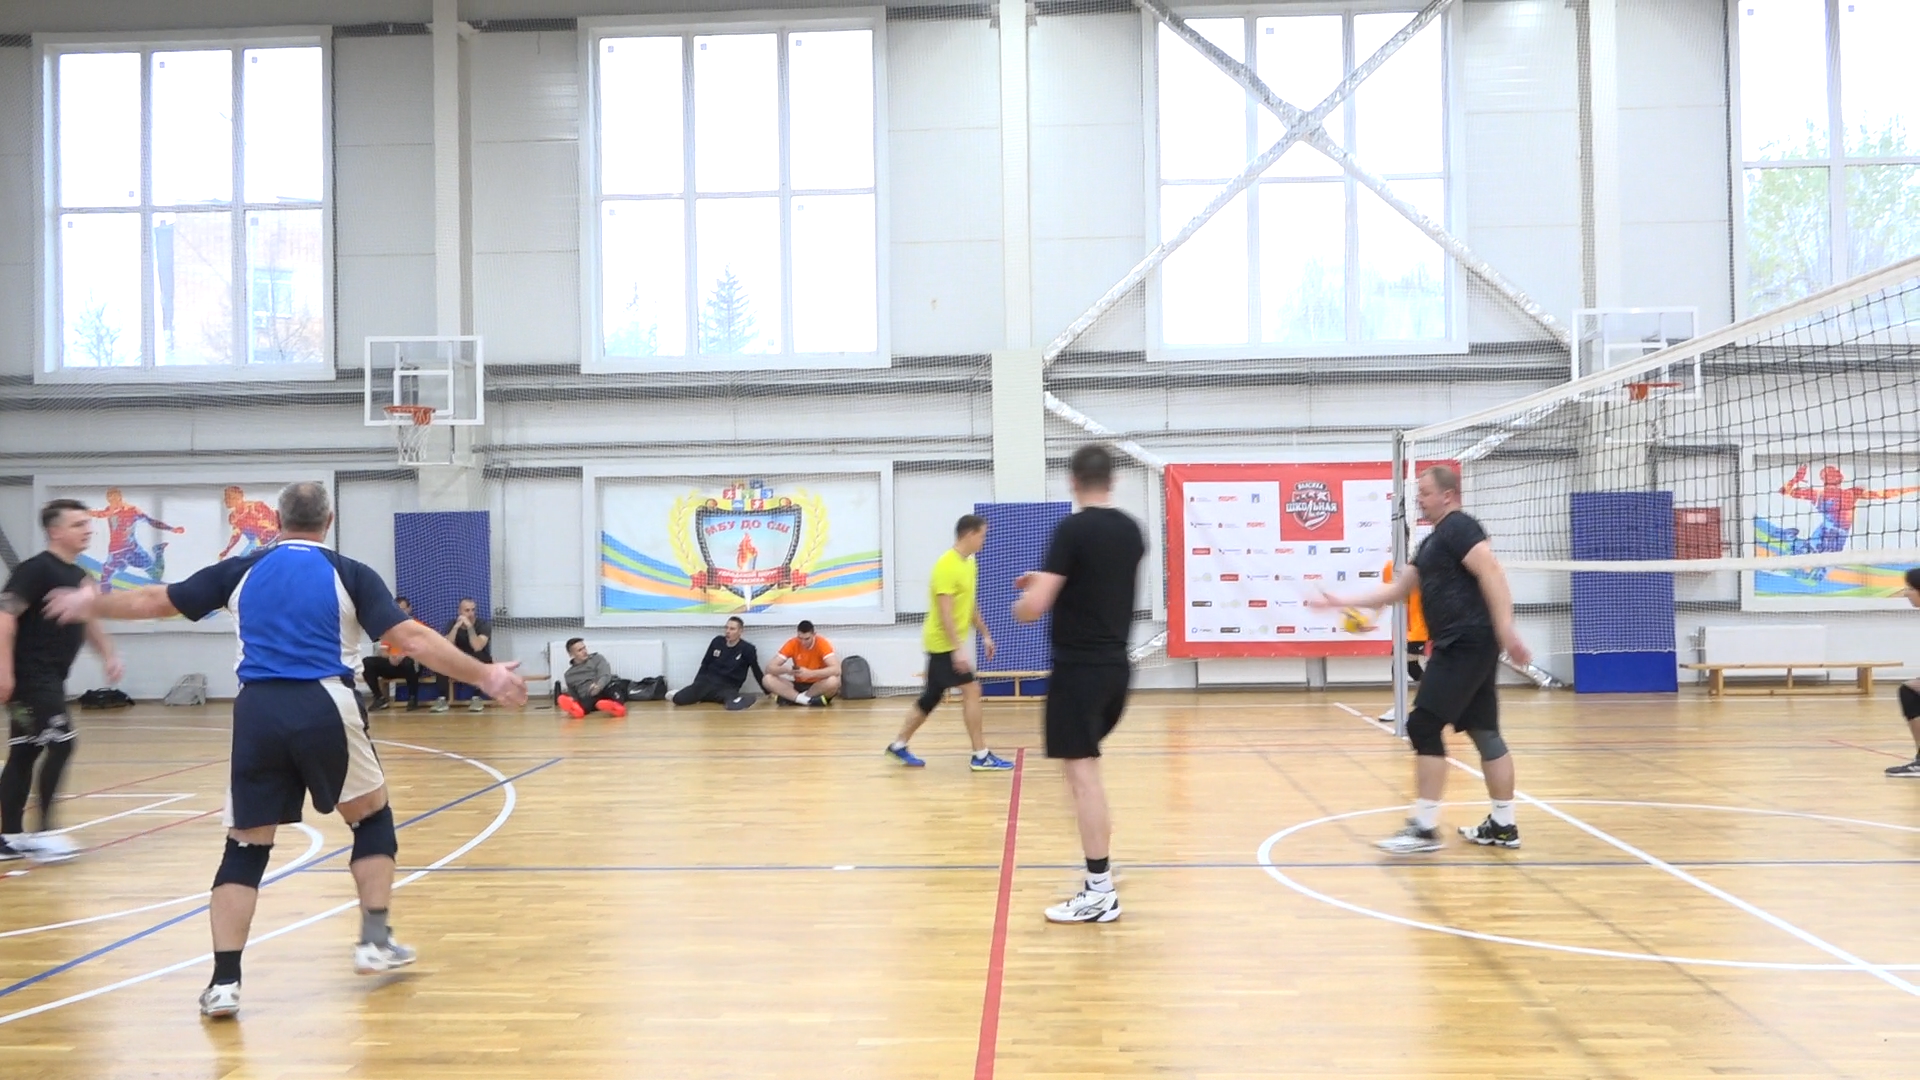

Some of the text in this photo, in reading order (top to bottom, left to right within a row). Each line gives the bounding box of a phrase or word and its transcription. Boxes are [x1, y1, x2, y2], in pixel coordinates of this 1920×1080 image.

[1286, 500, 1337, 514] ШКОЛЬНАЯ
[704, 519, 792, 536] МБУ ДО СШ
